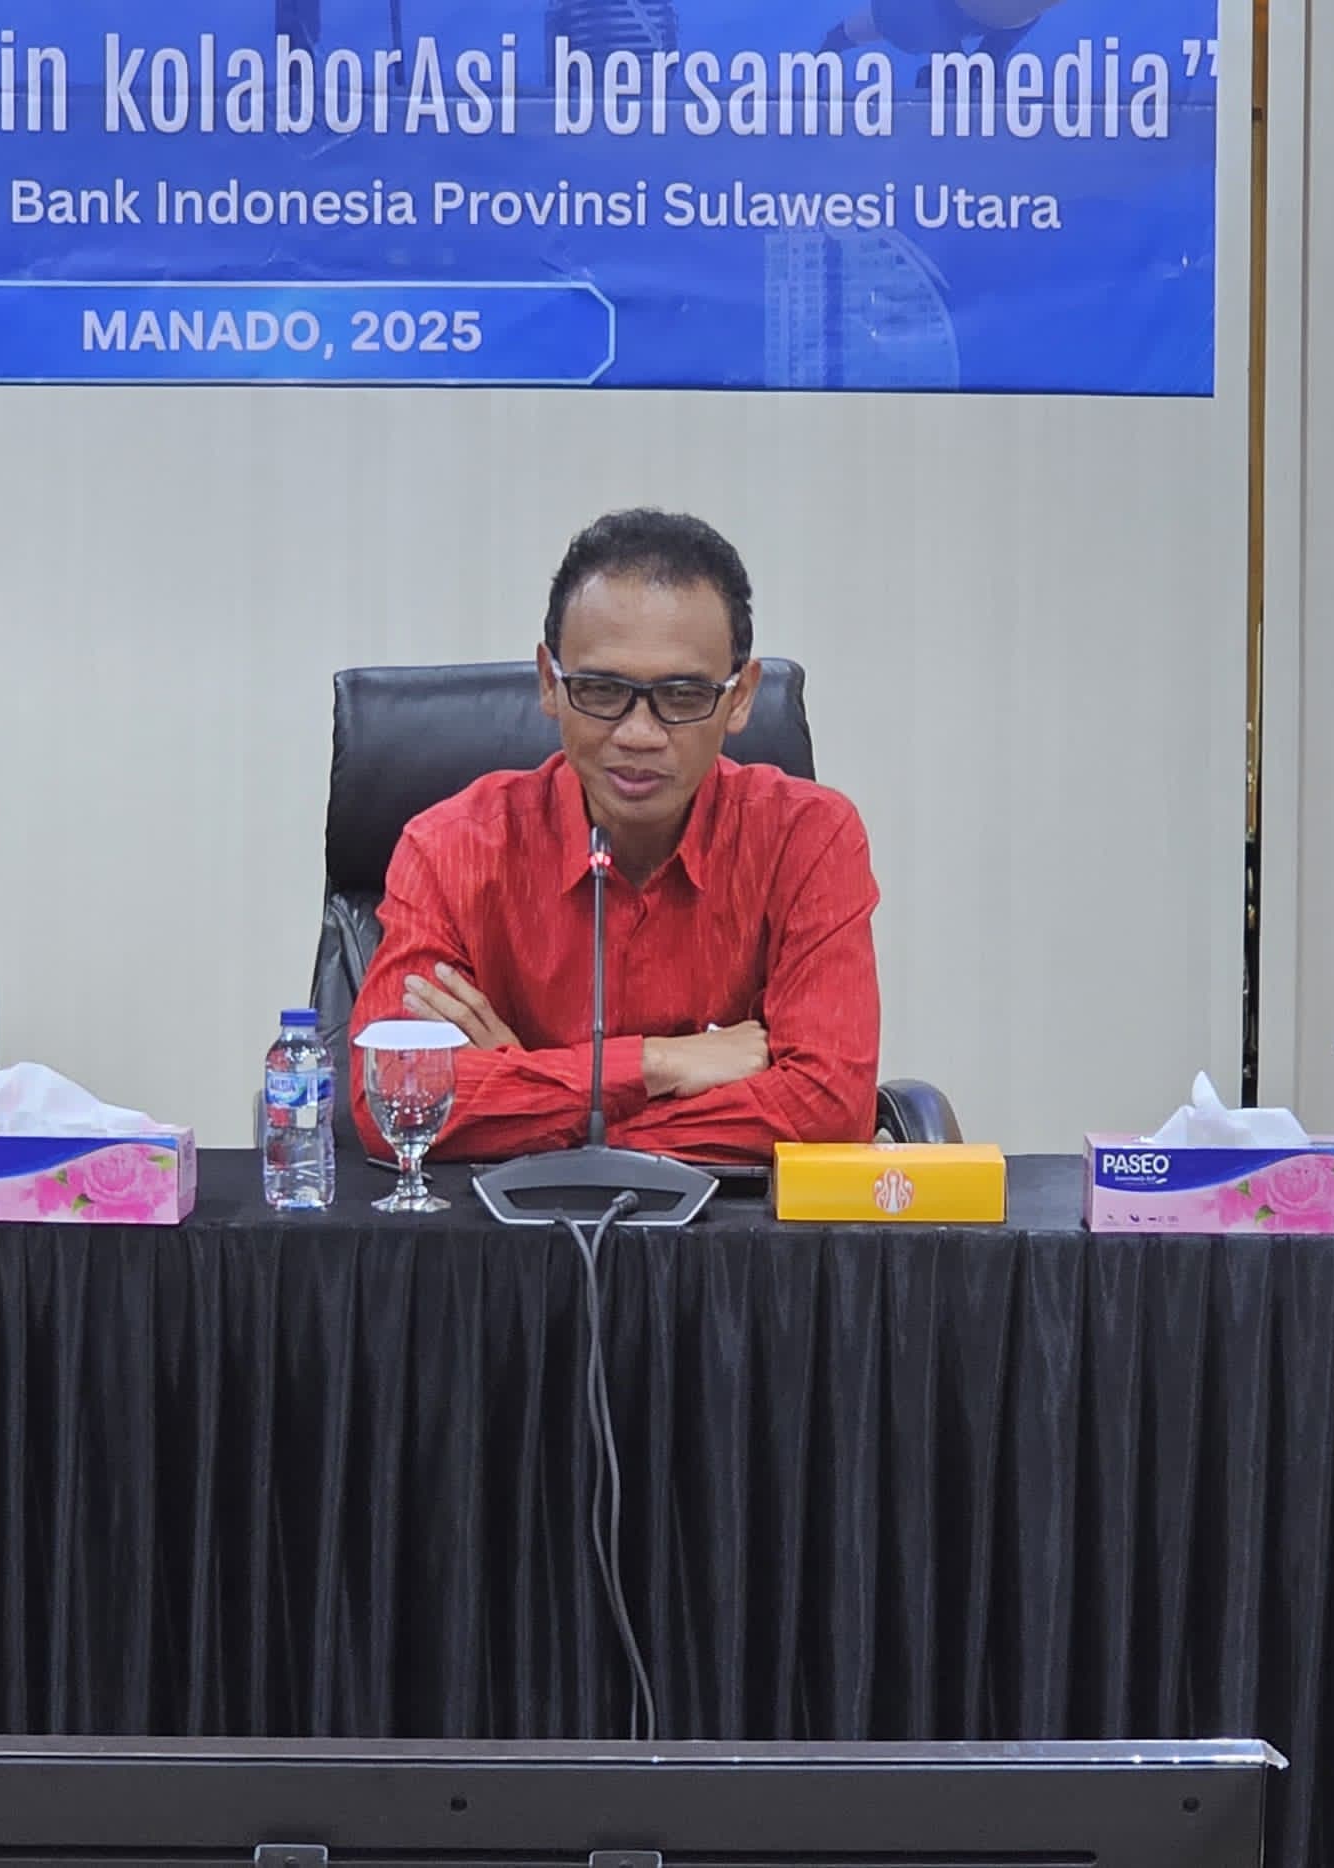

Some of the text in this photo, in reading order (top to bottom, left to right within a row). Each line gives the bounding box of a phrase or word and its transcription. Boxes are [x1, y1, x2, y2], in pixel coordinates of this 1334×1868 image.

[105, 33, 517, 135] kolaborAsi
[553, 36, 893, 138] bersama
[12, 178, 141, 225] Bank
[158, 179, 417, 226] Indonesia
[434, 180, 648, 228] Provinsi
[664, 181, 896, 229] Sulawesi
[915, 185, 1062, 230] Utara
[82, 310, 483, 359] MANADO, 2025
[1102, 1153, 1170, 1174] PASEO
